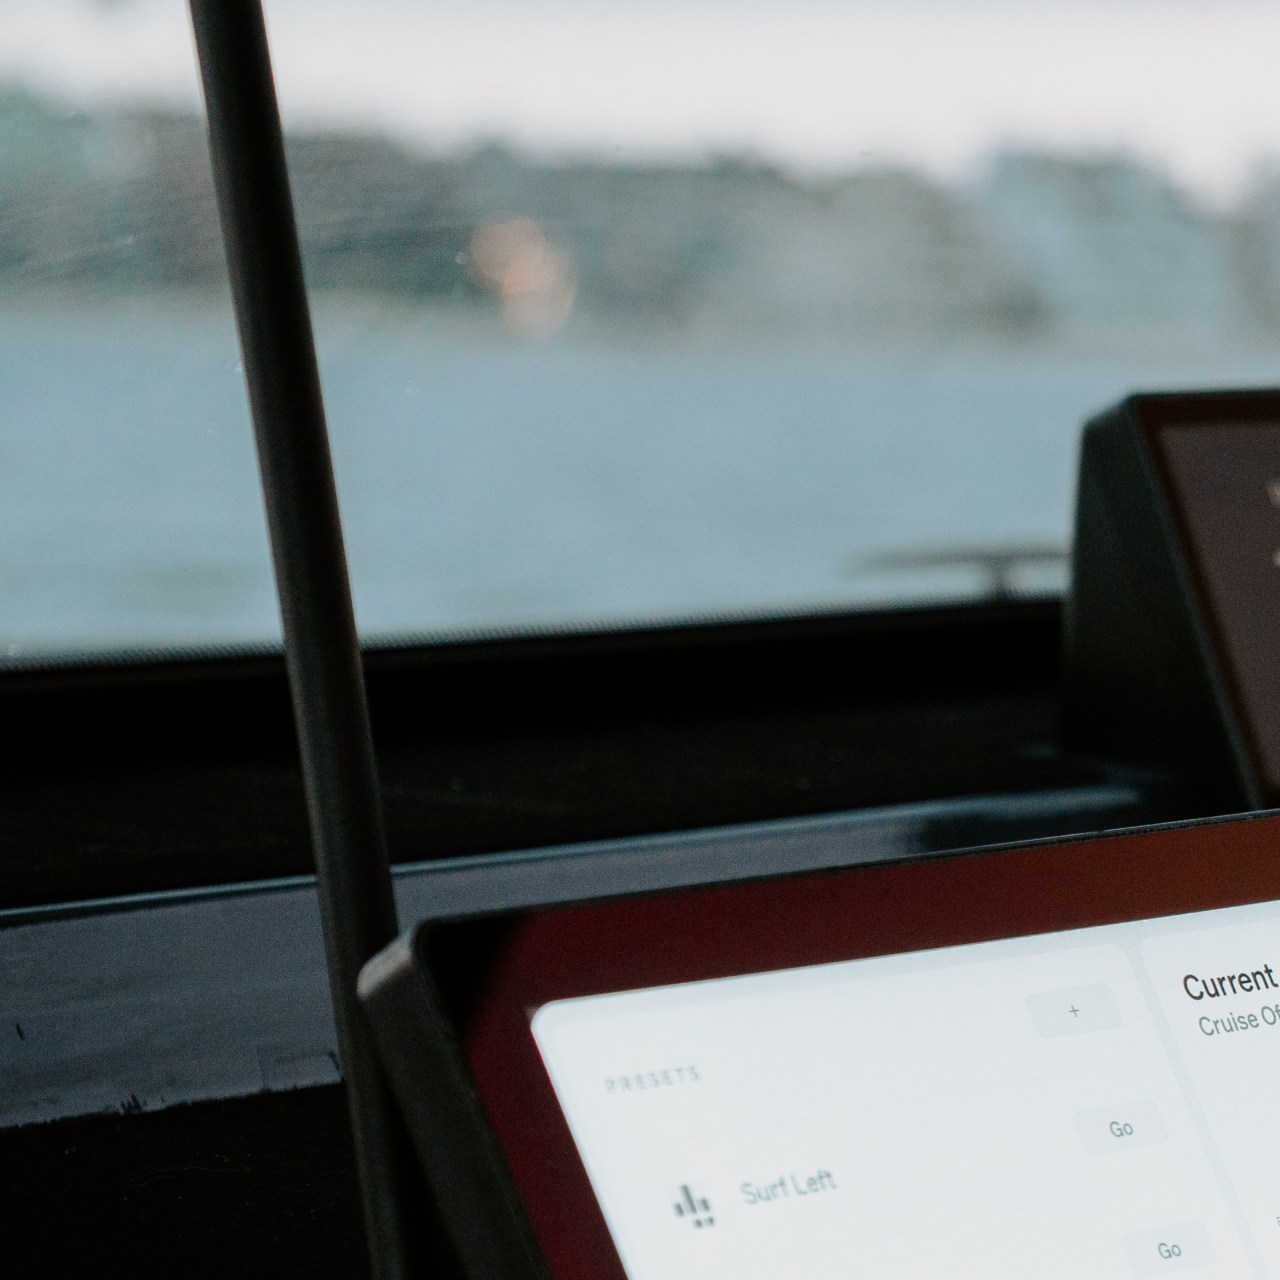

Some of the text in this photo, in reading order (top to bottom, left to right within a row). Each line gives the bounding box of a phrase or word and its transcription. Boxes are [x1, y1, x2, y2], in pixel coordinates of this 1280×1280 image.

[1183, 963, 1279, 1003] Current
[1198, 1008, 1258, 1038] Cruise
[604, 1064, 702, 1095] PRESETS
[1108, 1120, 1134, 1138] Go
[740, 1168, 838, 1206] Surf Left
[1157, 1241, 1182, 1260] Go
